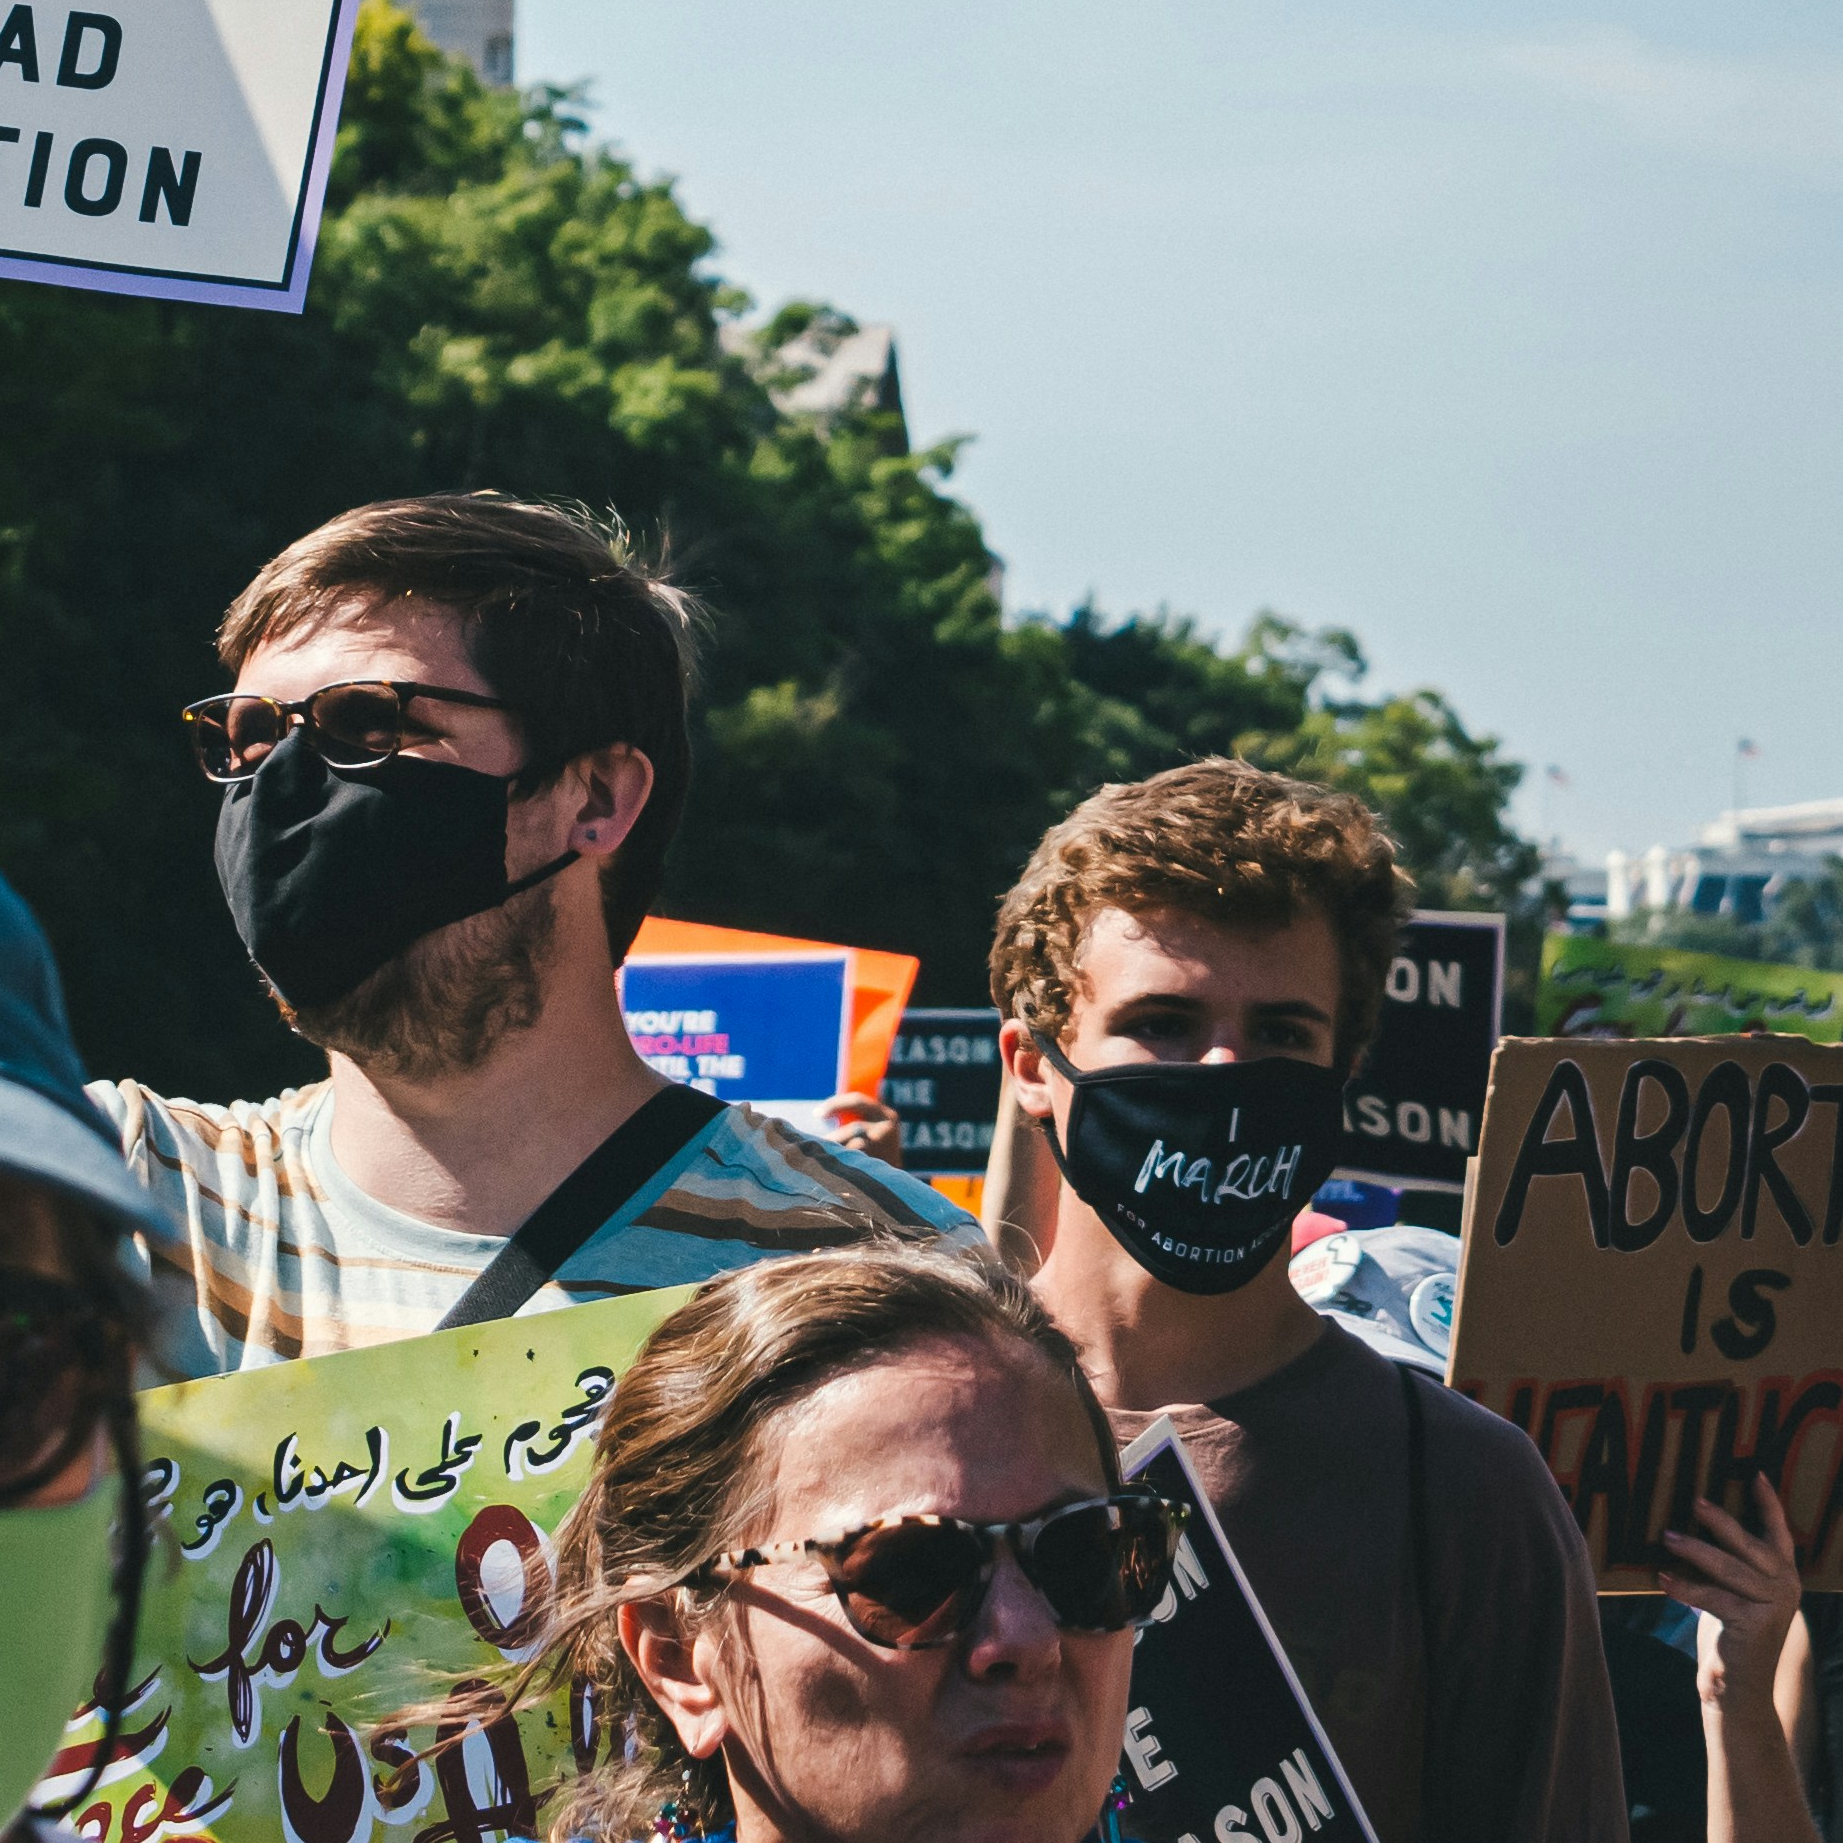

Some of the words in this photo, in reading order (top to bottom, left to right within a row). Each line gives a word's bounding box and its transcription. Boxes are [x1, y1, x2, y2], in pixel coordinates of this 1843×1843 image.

[625, 1010, 717, 1034] YOU'RE
[891, 1035, 996, 1065] EASON
[696, 1054, 746, 1079] THE
[884, 1078, 934, 1107] HE
[1229, 1107, 1239, 1142] I
[1343, 1095, 1471, 1151] SON
[1134, 1139, 1302, 1205] MARCH
[1117, 1203, 1146, 1230] FOR
[1151, 1231, 1244, 1262] ABORTION
[1680, 1264, 1792, 1360] IS
[1459, 1377, 1843, 1575] EALTHC
[187, 1538, 390, 1748] for
